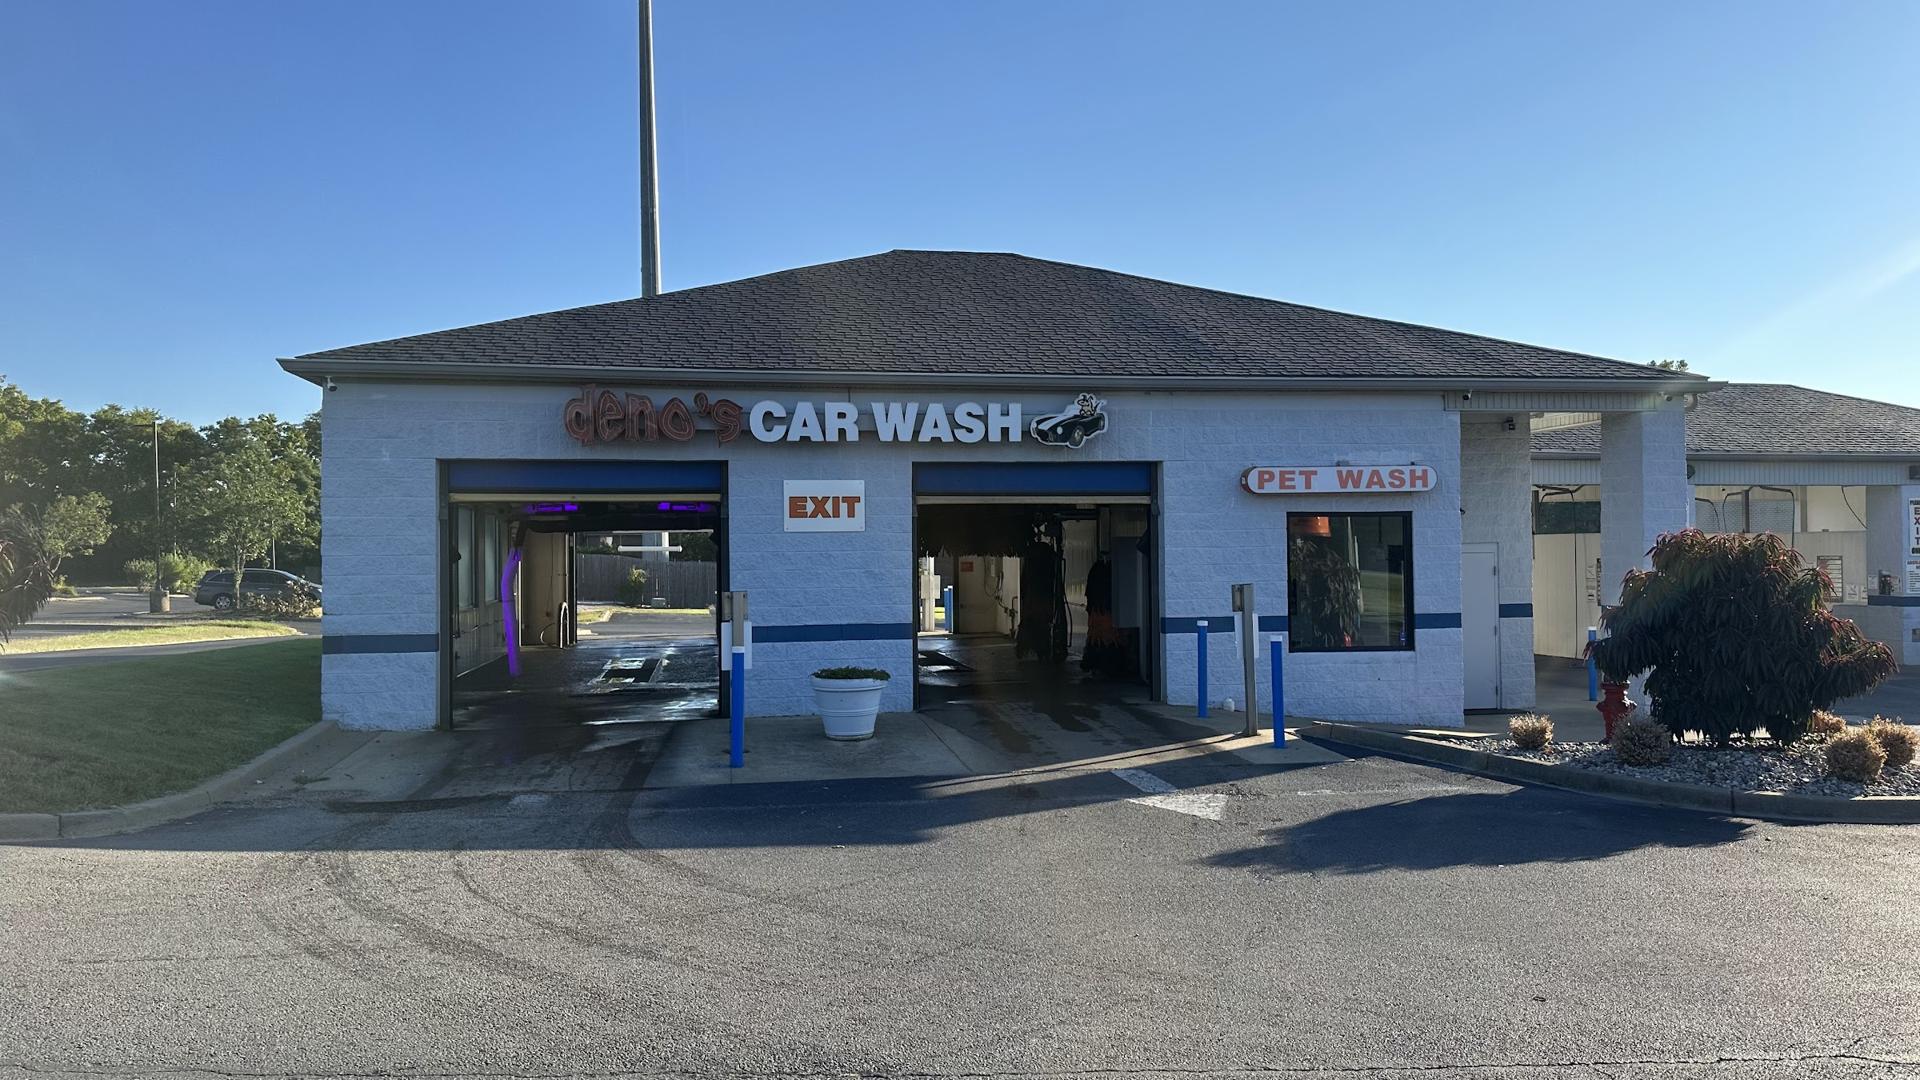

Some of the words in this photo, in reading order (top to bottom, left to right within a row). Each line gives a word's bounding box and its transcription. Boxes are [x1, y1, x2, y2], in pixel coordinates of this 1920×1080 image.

[565, 384, 743, 445] deno's
[750, 400, 859, 442] CAR
[871, 401, 1023, 443] WASH
[1257, 470, 1318, 489] PET
[1336, 469, 1428, 488] WASH
[788, 496, 861, 518] EXIT
